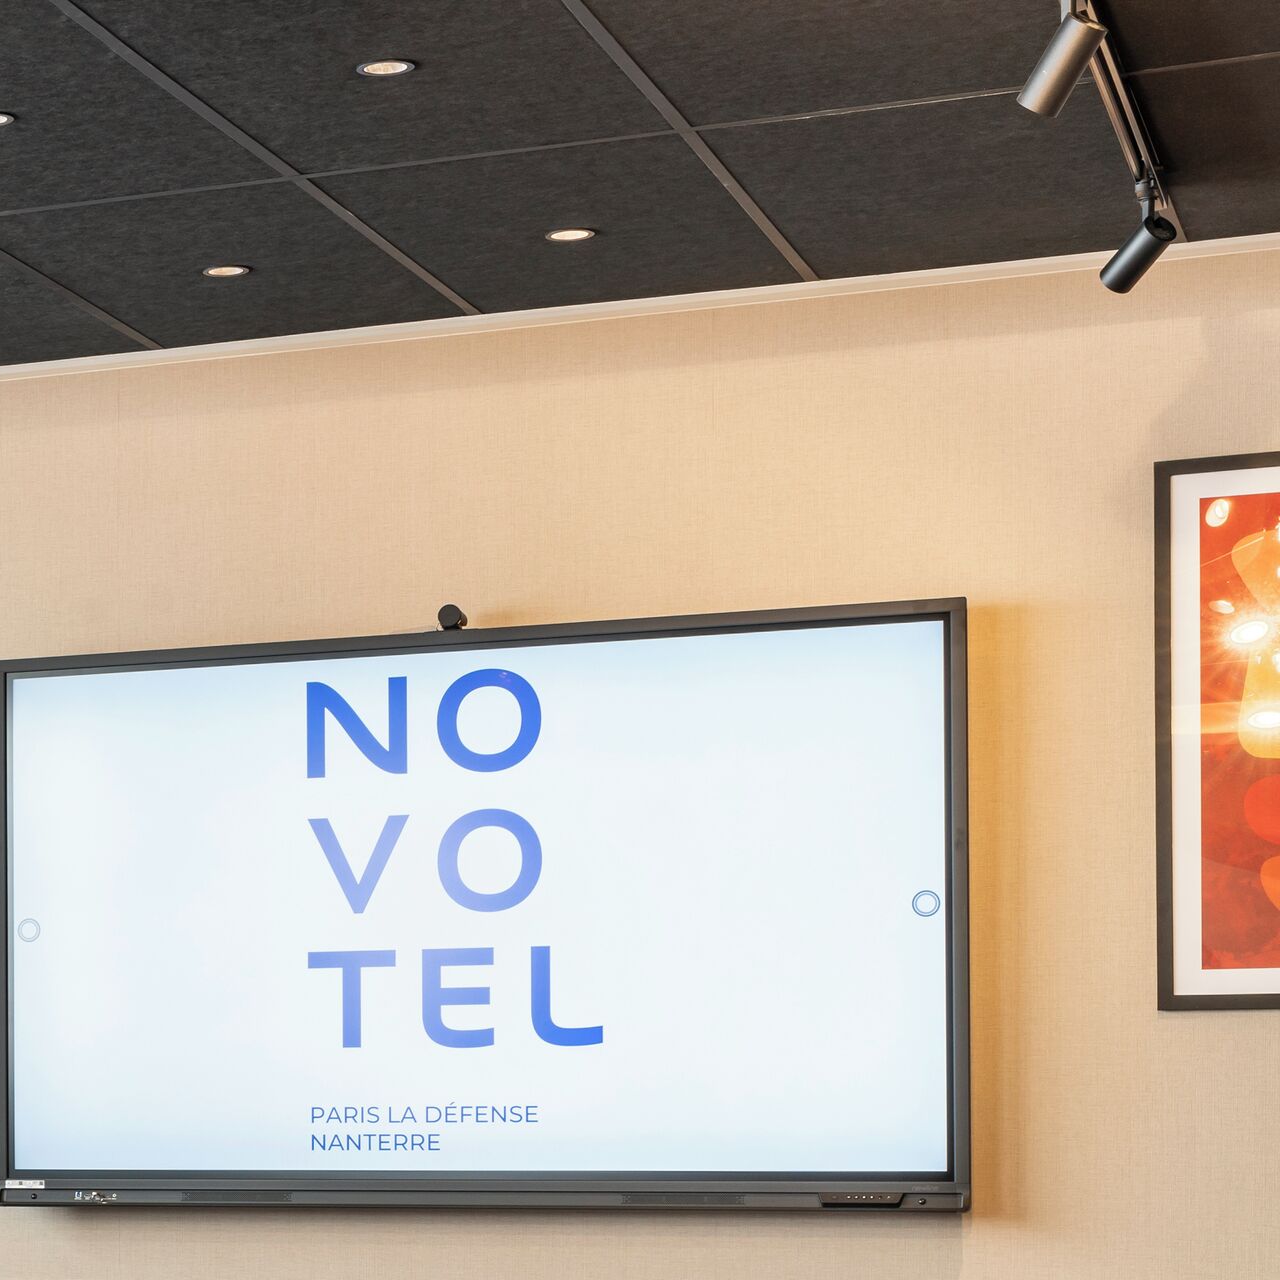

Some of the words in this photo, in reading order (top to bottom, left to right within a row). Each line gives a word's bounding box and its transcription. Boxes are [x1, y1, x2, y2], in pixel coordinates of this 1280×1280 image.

[305, 667, 544, 780] NO
[306, 808, 545, 915] VO
[306, 944, 605, 1050] TEL
[309, 1105, 382, 1125] PARIS
[388, 1104, 418, 1125] LA
[423, 1098, 540, 1125] DÉFENSE
[309, 1132, 443, 1152] NANTERRE
